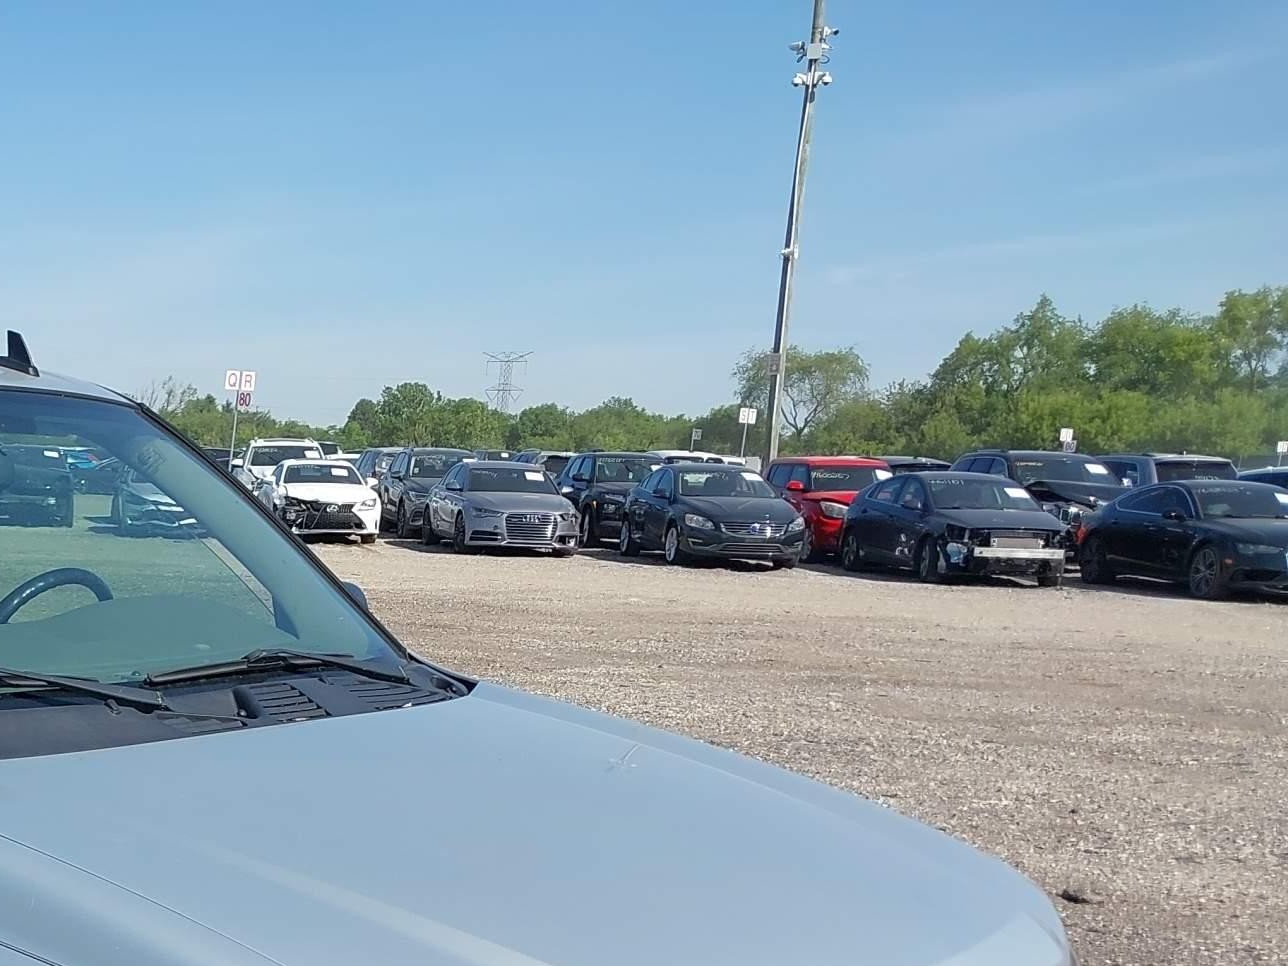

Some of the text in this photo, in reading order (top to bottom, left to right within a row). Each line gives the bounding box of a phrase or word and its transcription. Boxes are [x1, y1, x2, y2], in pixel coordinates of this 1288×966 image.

[227, 372, 253, 389] Q R
[238, 392, 252, 407] 80
